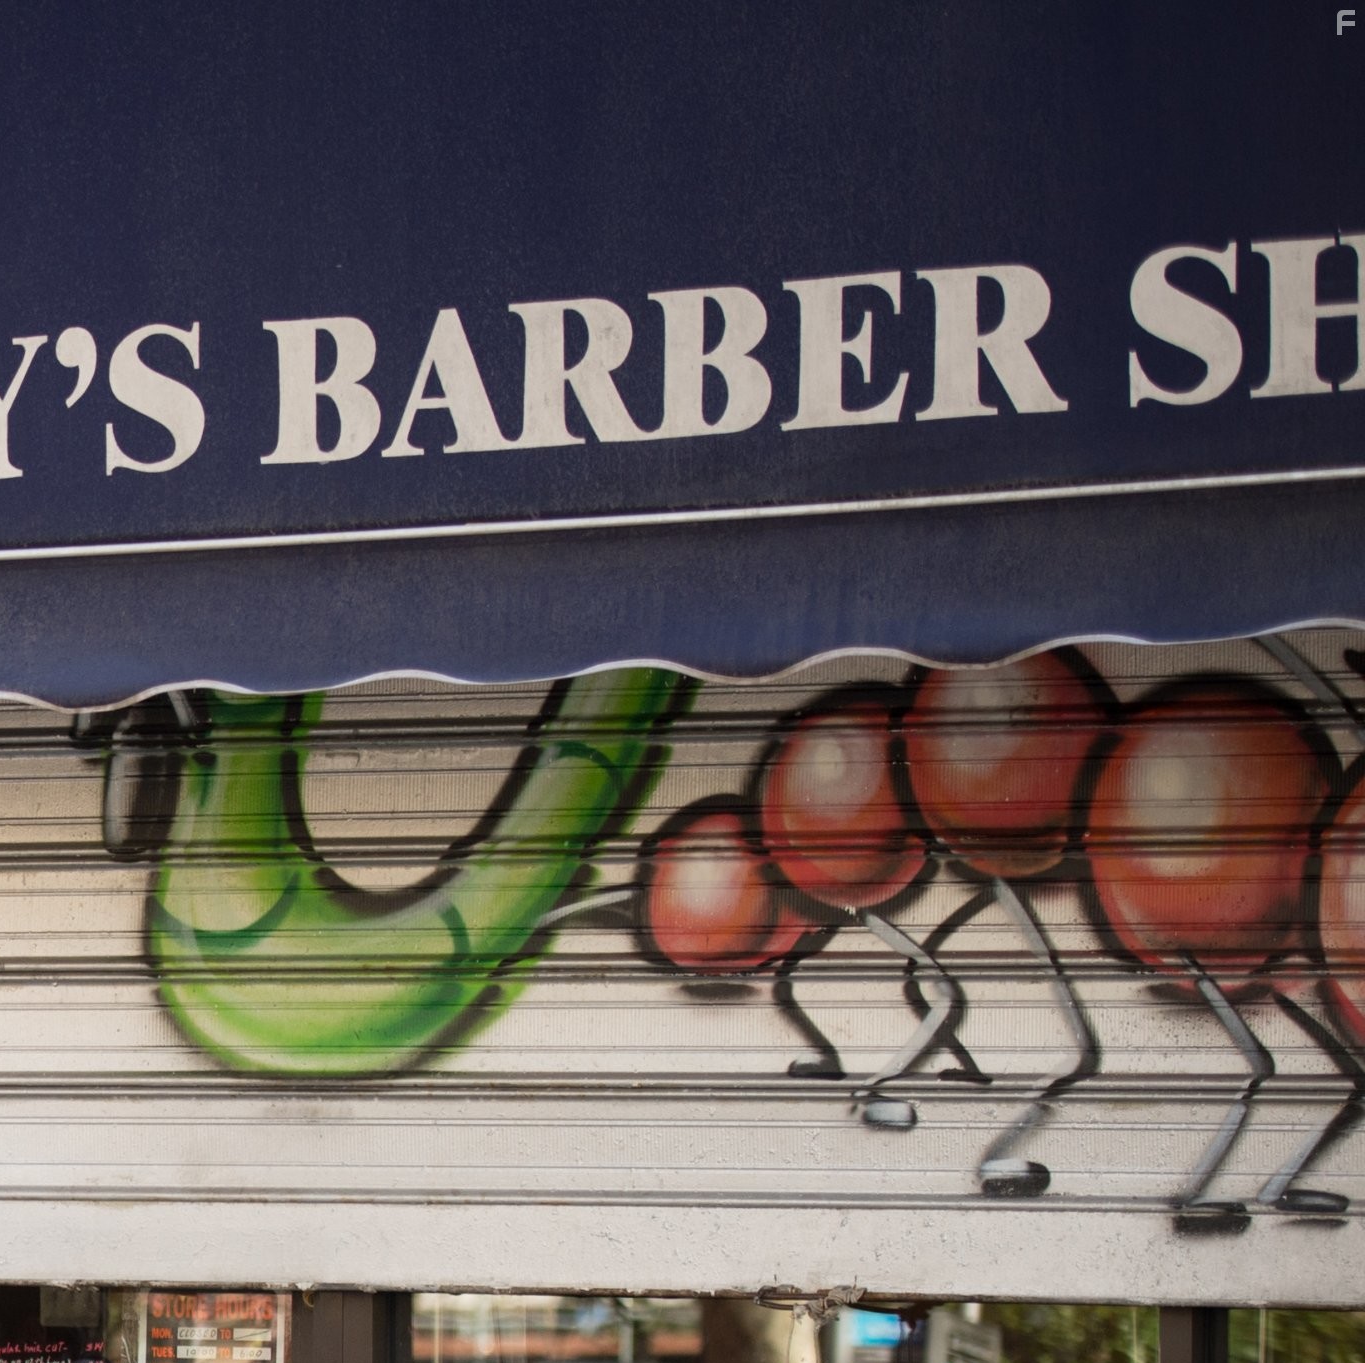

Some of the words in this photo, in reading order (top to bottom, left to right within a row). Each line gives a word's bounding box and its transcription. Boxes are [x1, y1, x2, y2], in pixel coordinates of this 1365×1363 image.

[260, 263, 1069, 466] BARBER
[151, 1293, 210, 1319] STORE
[214, 1293, 274, 1320] HOURS
[219, 1328, 232, 1340] TO
[219, 1347, 230, 1358] TO
